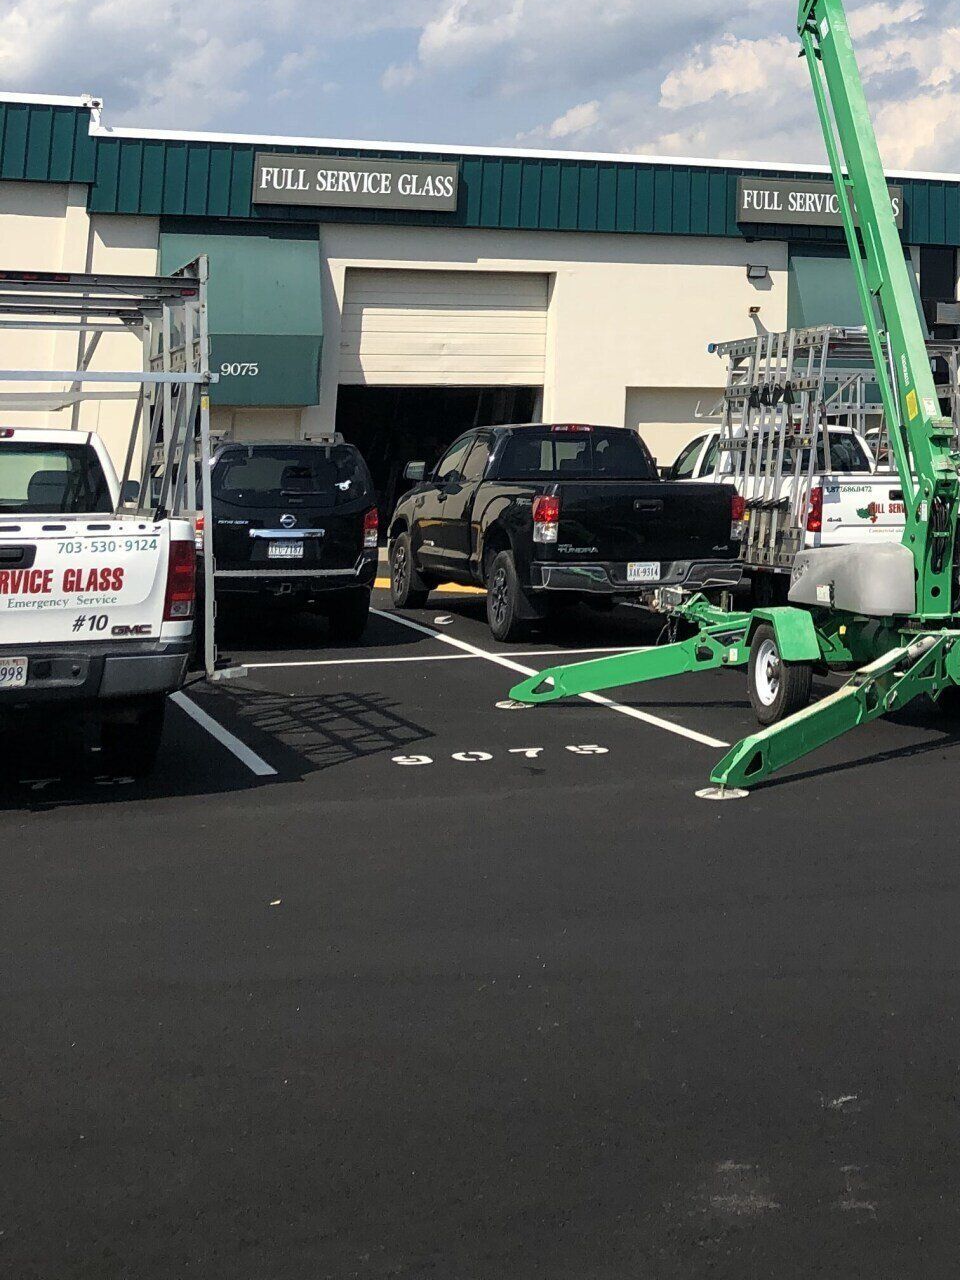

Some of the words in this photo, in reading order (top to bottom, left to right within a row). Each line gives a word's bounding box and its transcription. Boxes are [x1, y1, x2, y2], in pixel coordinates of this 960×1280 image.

[260, 167, 310, 191] FULL
[316, 169, 392, 194] SERVICE
[397, 173, 454, 197] GLASS
[742, 189, 783, 211] FULL
[788, 191, 842, 214] SERVIC
[220, 362, 259, 376] 9075
[0, 569, 54, 594] RVICE
[62, 567, 125, 593] GLASS
[7, 598, 70, 609] Emergency
[76, 595, 118, 606] Service
[72, 614, 109, 632] #10
[111, 624, 152, 636] GMC
[391, 744, 610, 766] 9075
